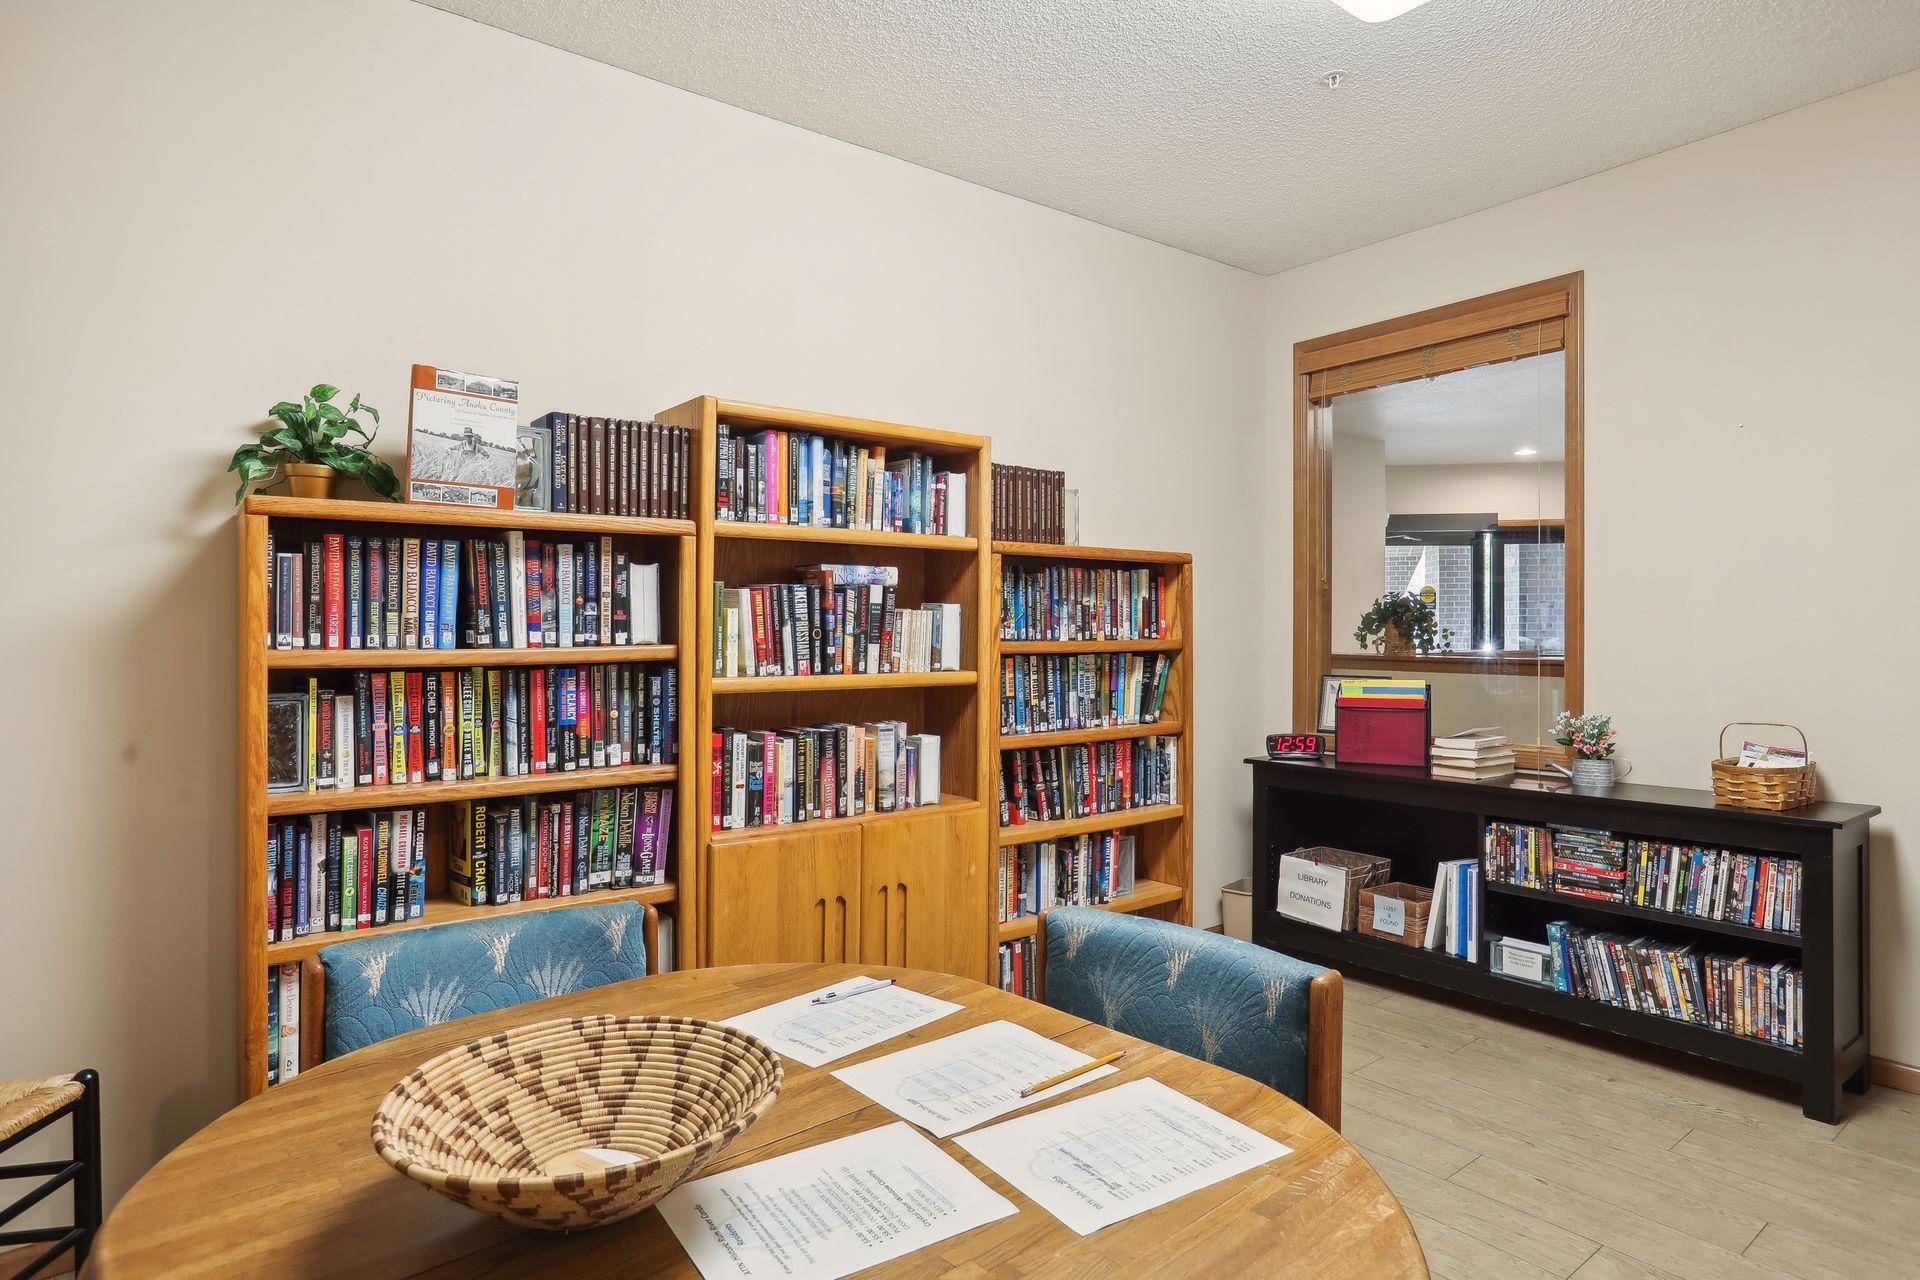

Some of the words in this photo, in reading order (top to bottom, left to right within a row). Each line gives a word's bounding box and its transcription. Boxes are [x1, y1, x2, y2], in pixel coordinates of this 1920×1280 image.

[490, 403, 515, 416] County
[720, 438, 728, 458] STEPHEN
[561, 475, 566, 484] OF
[720, 460, 728, 478] HUNTER
[312, 546, 320, 563] DAVID
[329, 537, 339, 560] DAVID
[351, 550, 360, 567] DAVID
[371, 550, 379, 568] DAVID
[406, 544, 418, 570] DAVID
[426, 543, 437, 566] DAVID
[444, 544, 455, 570] DAVID
[495, 548, 505, 567] DAVID
[562, 548, 571, 570] DAVID
[388, 551, 398, 573] DAVID
[477, 553, 485, 572] DAVID
[330, 563, 339, 600] BALDACCI
[351, 569, 360, 599] BALDACCI
[371, 570, 379, 600] BALDACCI
[388, 575, 398, 609] BALDACCI
[406, 572, 417, 613] BALDACCI
[426, 569, 436, 608] BALDACCI
[479, 575, 488, 605] BALDACCI
[496, 570, 506, 602] BALDACCI
[562, 571, 571, 604] BALDACCI
[795, 591, 808, 613] KERR
[426, 611, 434, 621] END
[796, 614, 810, 654] PRUSSIAN
[567, 677, 576, 691] TOM
[567, 694, 576, 720] CLANCY
[1277, 737, 1316, 751] 12:59
[465, 754, 471, 763] ME
[840, 752, 845, 761] OF
[620, 792, 633, 817] Nelson
[476, 806, 485, 848] ROBERT
[511, 809, 520, 834] PATRICIA
[579, 816, 588, 836] Nelson
[599, 810, 609, 841] MAZE
[379, 821, 388, 849] PATRICIA
[619, 819, 632, 848] DeMille
[398, 841, 406, 868] CRICHTON
[511, 836, 520, 867] CORNWELL
[579, 838, 587, 858] DeMille
[284, 851, 292, 880] CORNWELL
[378, 850, 387, 884] CORNWELL
[640, 852, 653, 874] GAME
[476, 860, 485, 892] CRAIS
[1298, 873, 1328, 887] LIBRARY
[378, 888, 386, 910] CHAOS
[1289, 892, 1332, 910] DONATIONS
[1380, 918, 1398, 927] FOUND
[864, 1169, 887, 1185] Cleaning
[881, 1184, 905, 1201] Window
[692, 1203, 709, 1219] Condo
[899, 1200, 916, 1212] Clear
[702, 1217, 718, 1231] River
[911, 1211, 933, 1227] Crystal
[721, 1222, 747, 1246] Residents
[720, 1241, 742, 1262] Historic
